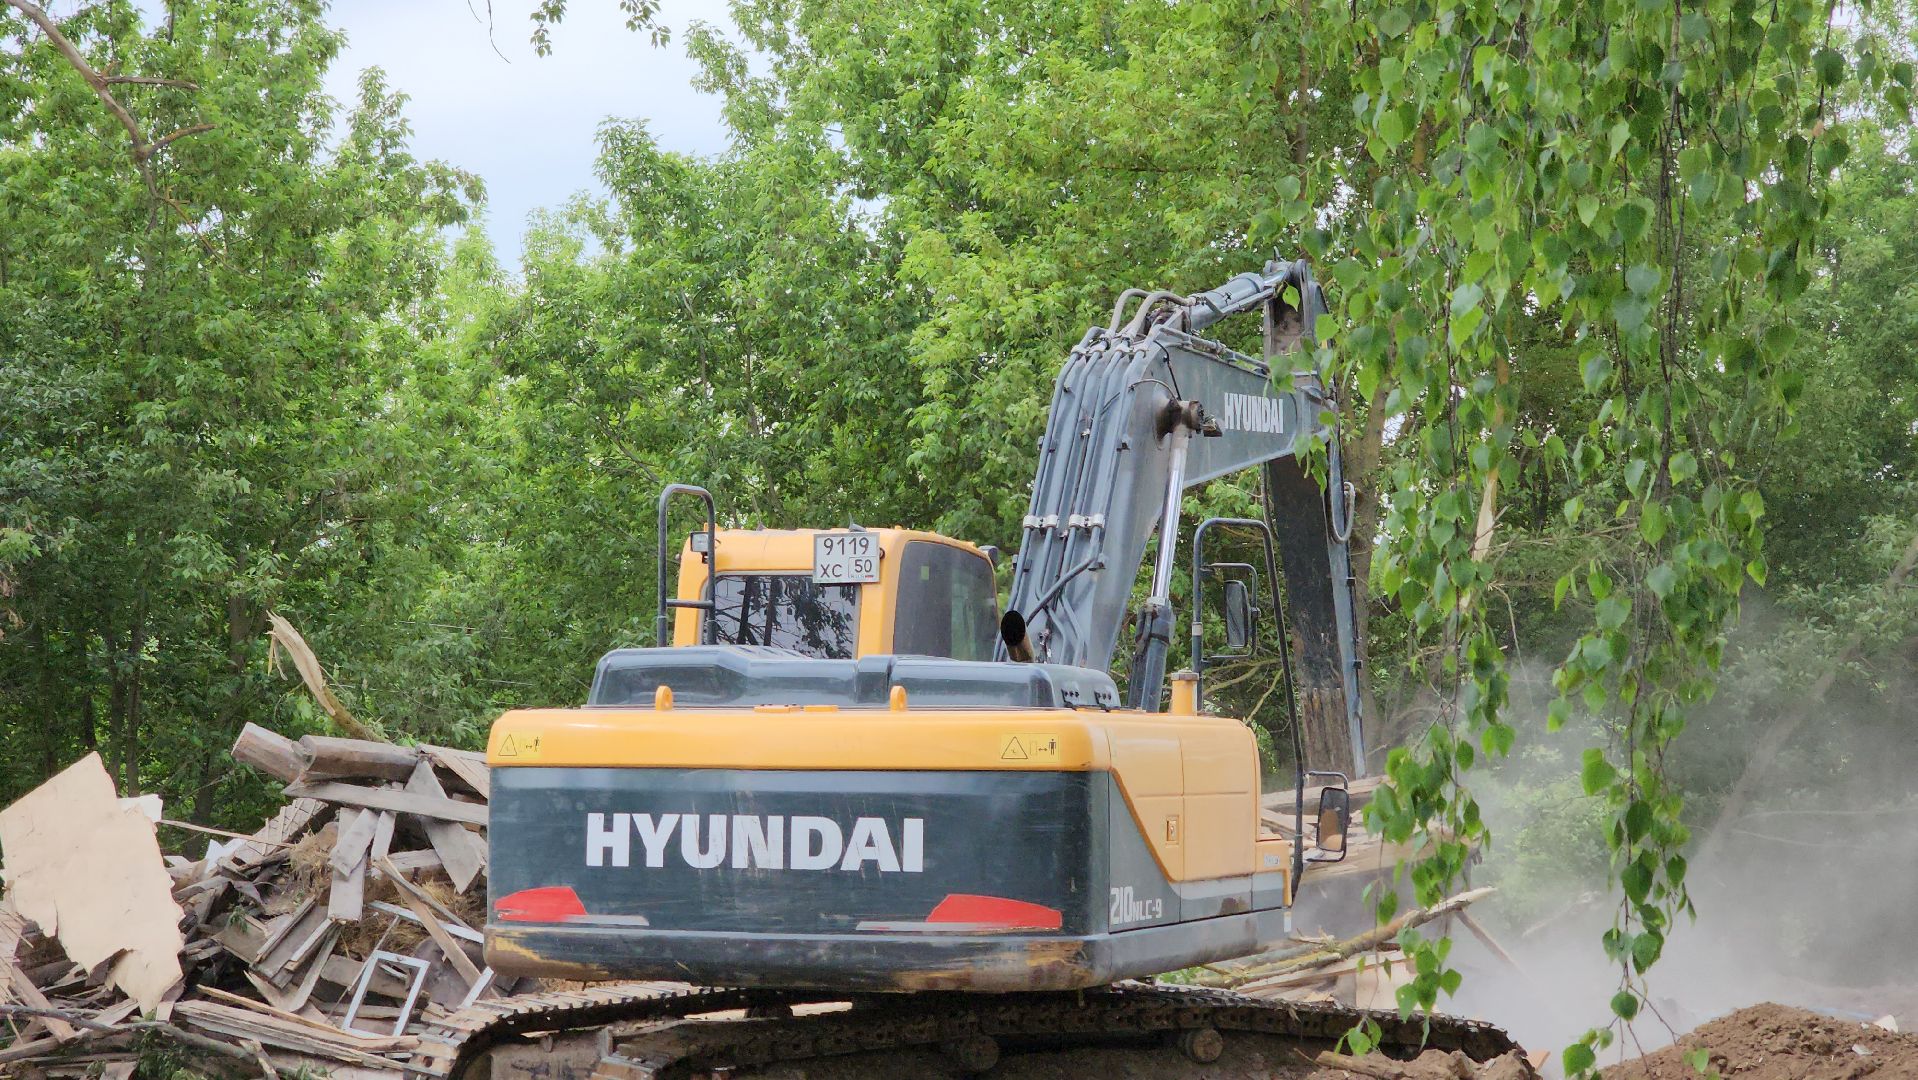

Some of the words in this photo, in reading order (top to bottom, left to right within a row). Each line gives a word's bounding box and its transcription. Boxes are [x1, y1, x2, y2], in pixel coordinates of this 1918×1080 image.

[1224, 392, 1284, 434] HYUNDAI
[823, 537, 869, 556] 9119
[820, 563, 842, 578] XC
[854, 558, 873, 573] 50
[586, 812, 924, 873] HYUNDAI
